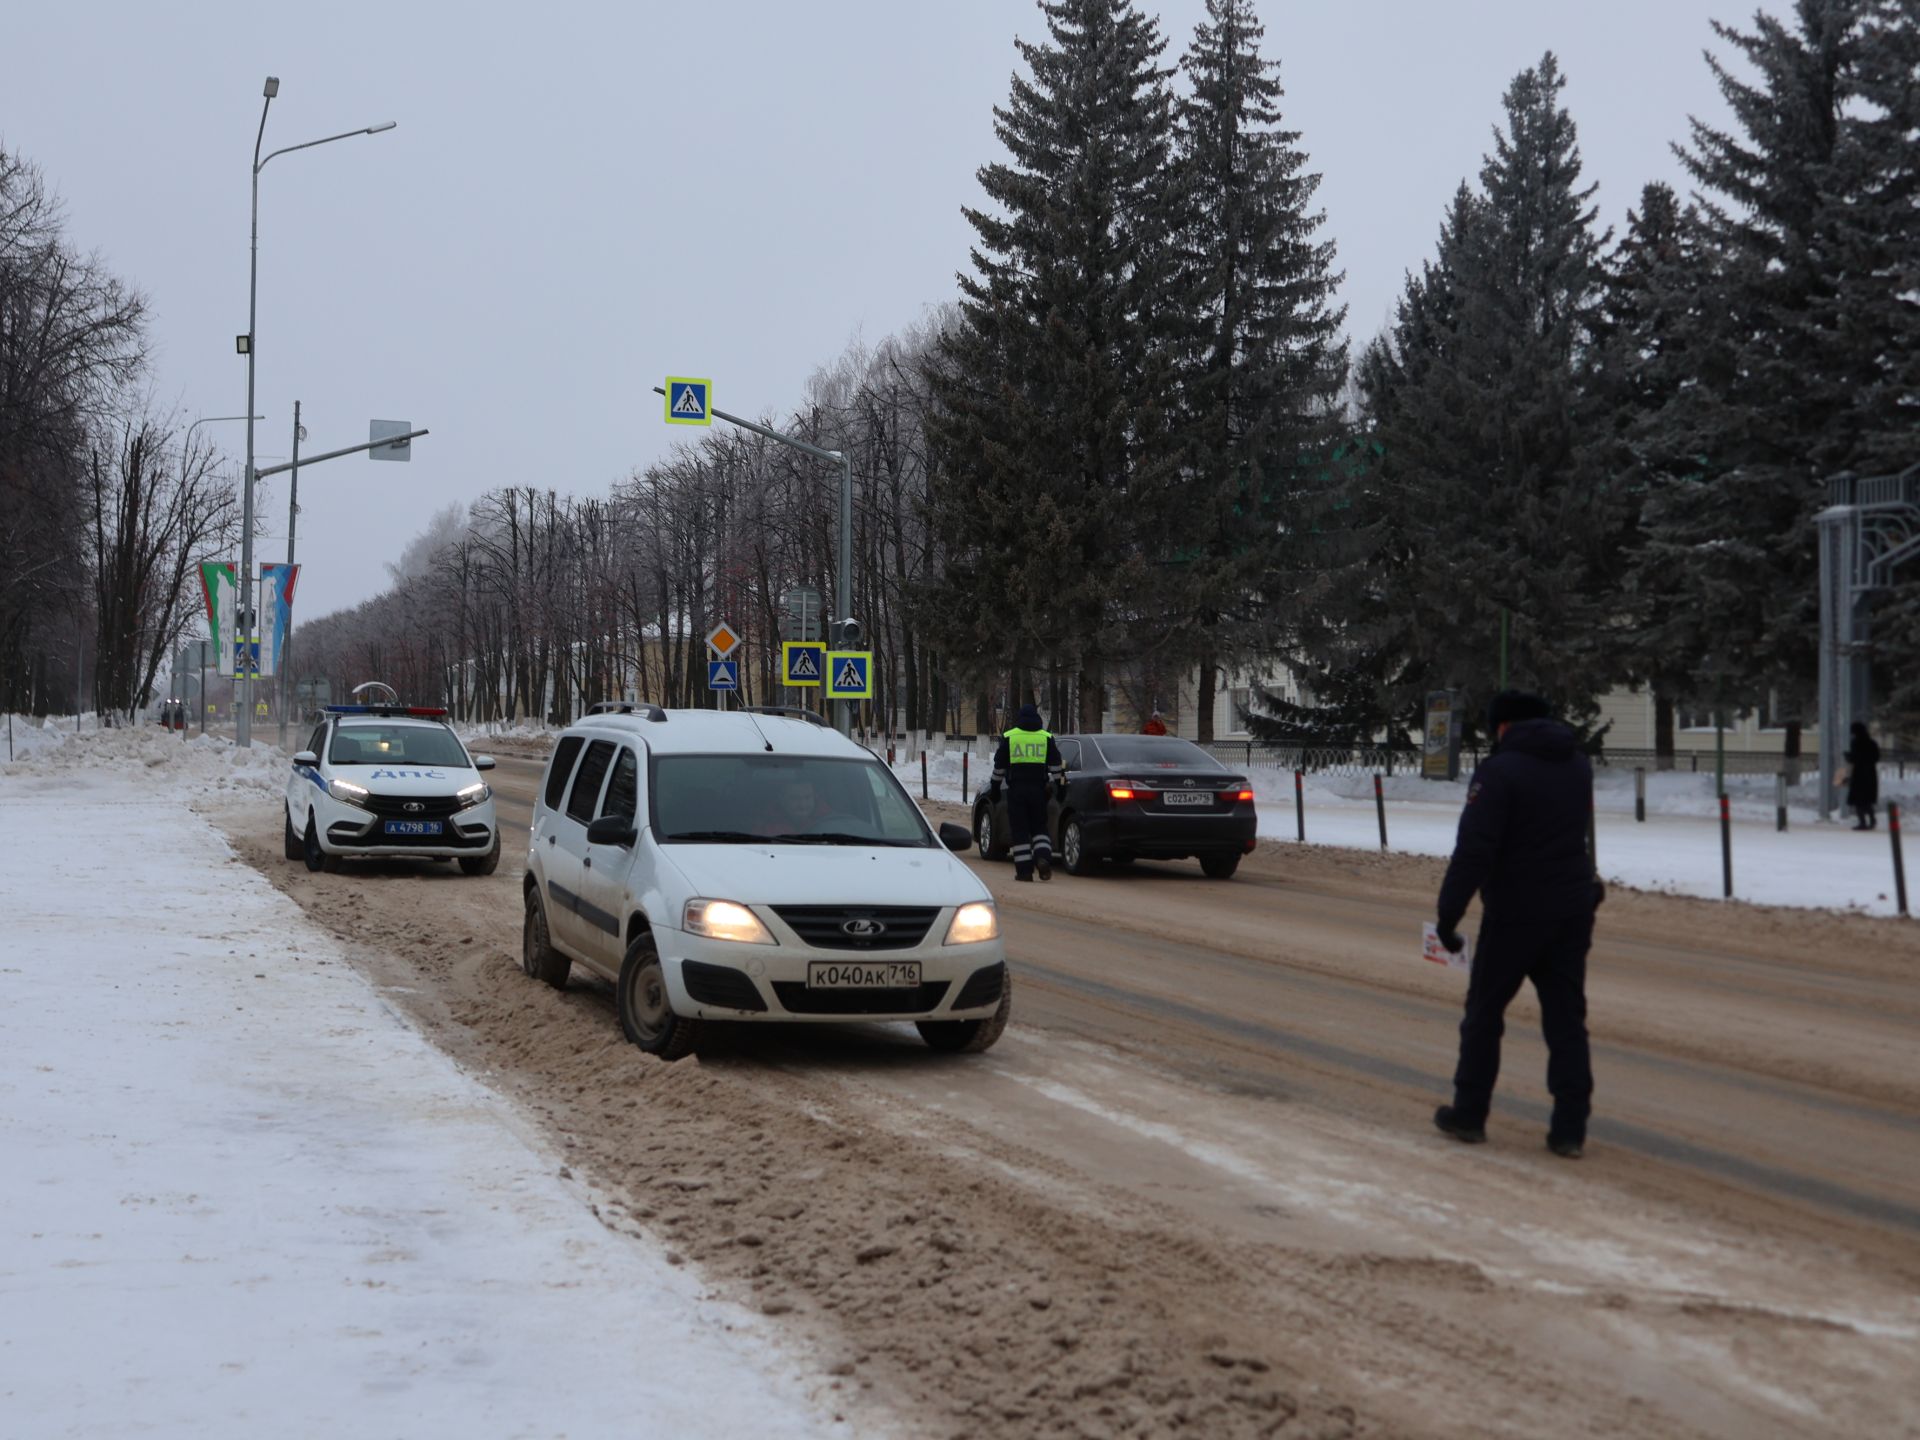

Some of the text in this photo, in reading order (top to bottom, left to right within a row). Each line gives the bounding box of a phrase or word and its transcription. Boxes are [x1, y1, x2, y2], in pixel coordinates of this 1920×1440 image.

[1011, 743, 1046, 758] ДПС
[371, 770, 446, 779] ДПС
[400, 823, 424, 833] 4798
[816, 965, 916, 985] К040АК 716
